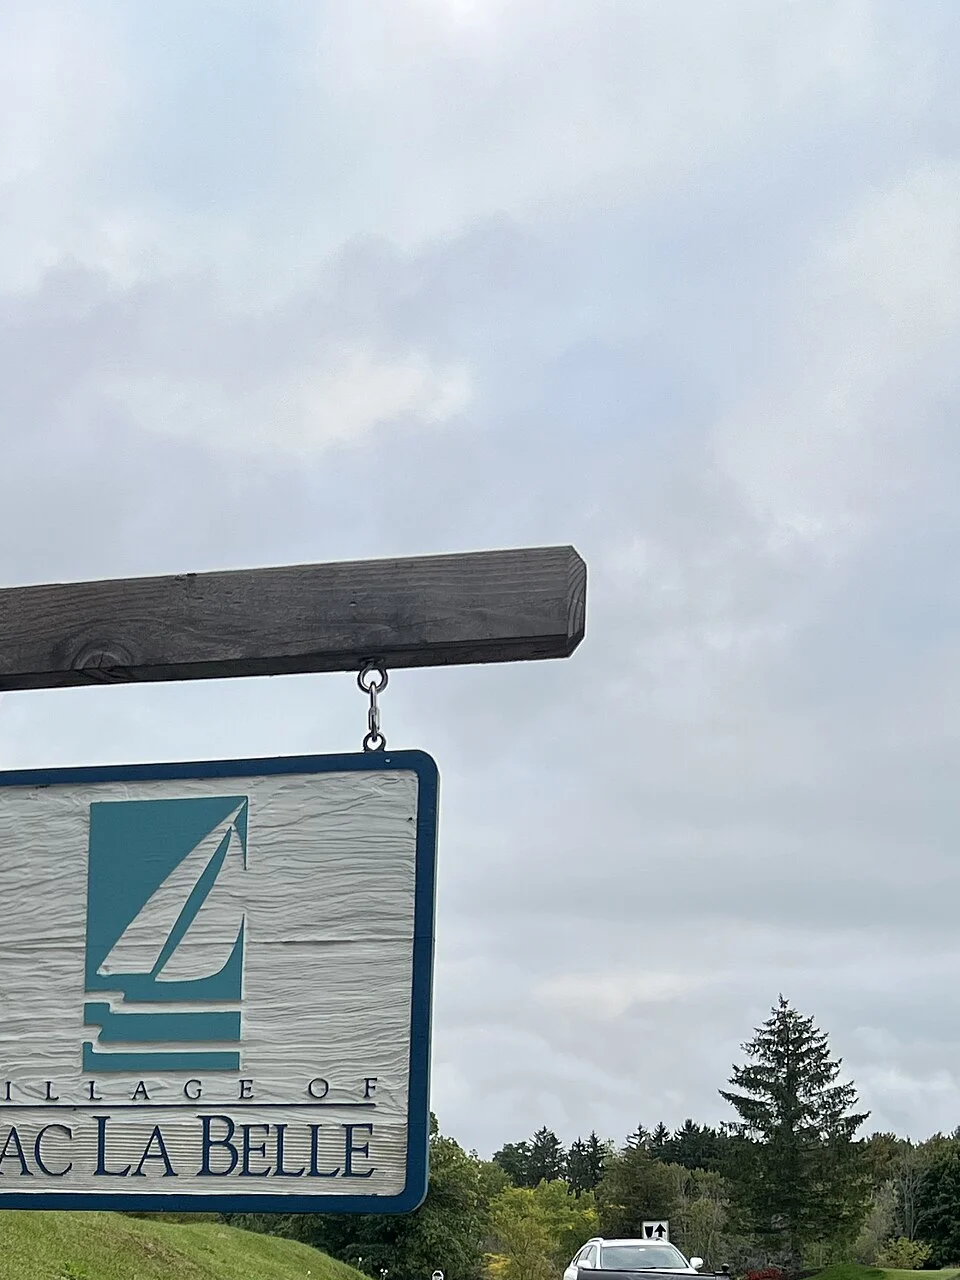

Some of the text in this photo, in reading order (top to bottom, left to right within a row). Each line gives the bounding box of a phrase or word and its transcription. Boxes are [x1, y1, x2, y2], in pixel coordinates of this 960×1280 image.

[308, 1078, 378, 1098] OF
[93, 1115, 179, 1176] LA
[197, 1114, 378, 1177] BELLE
